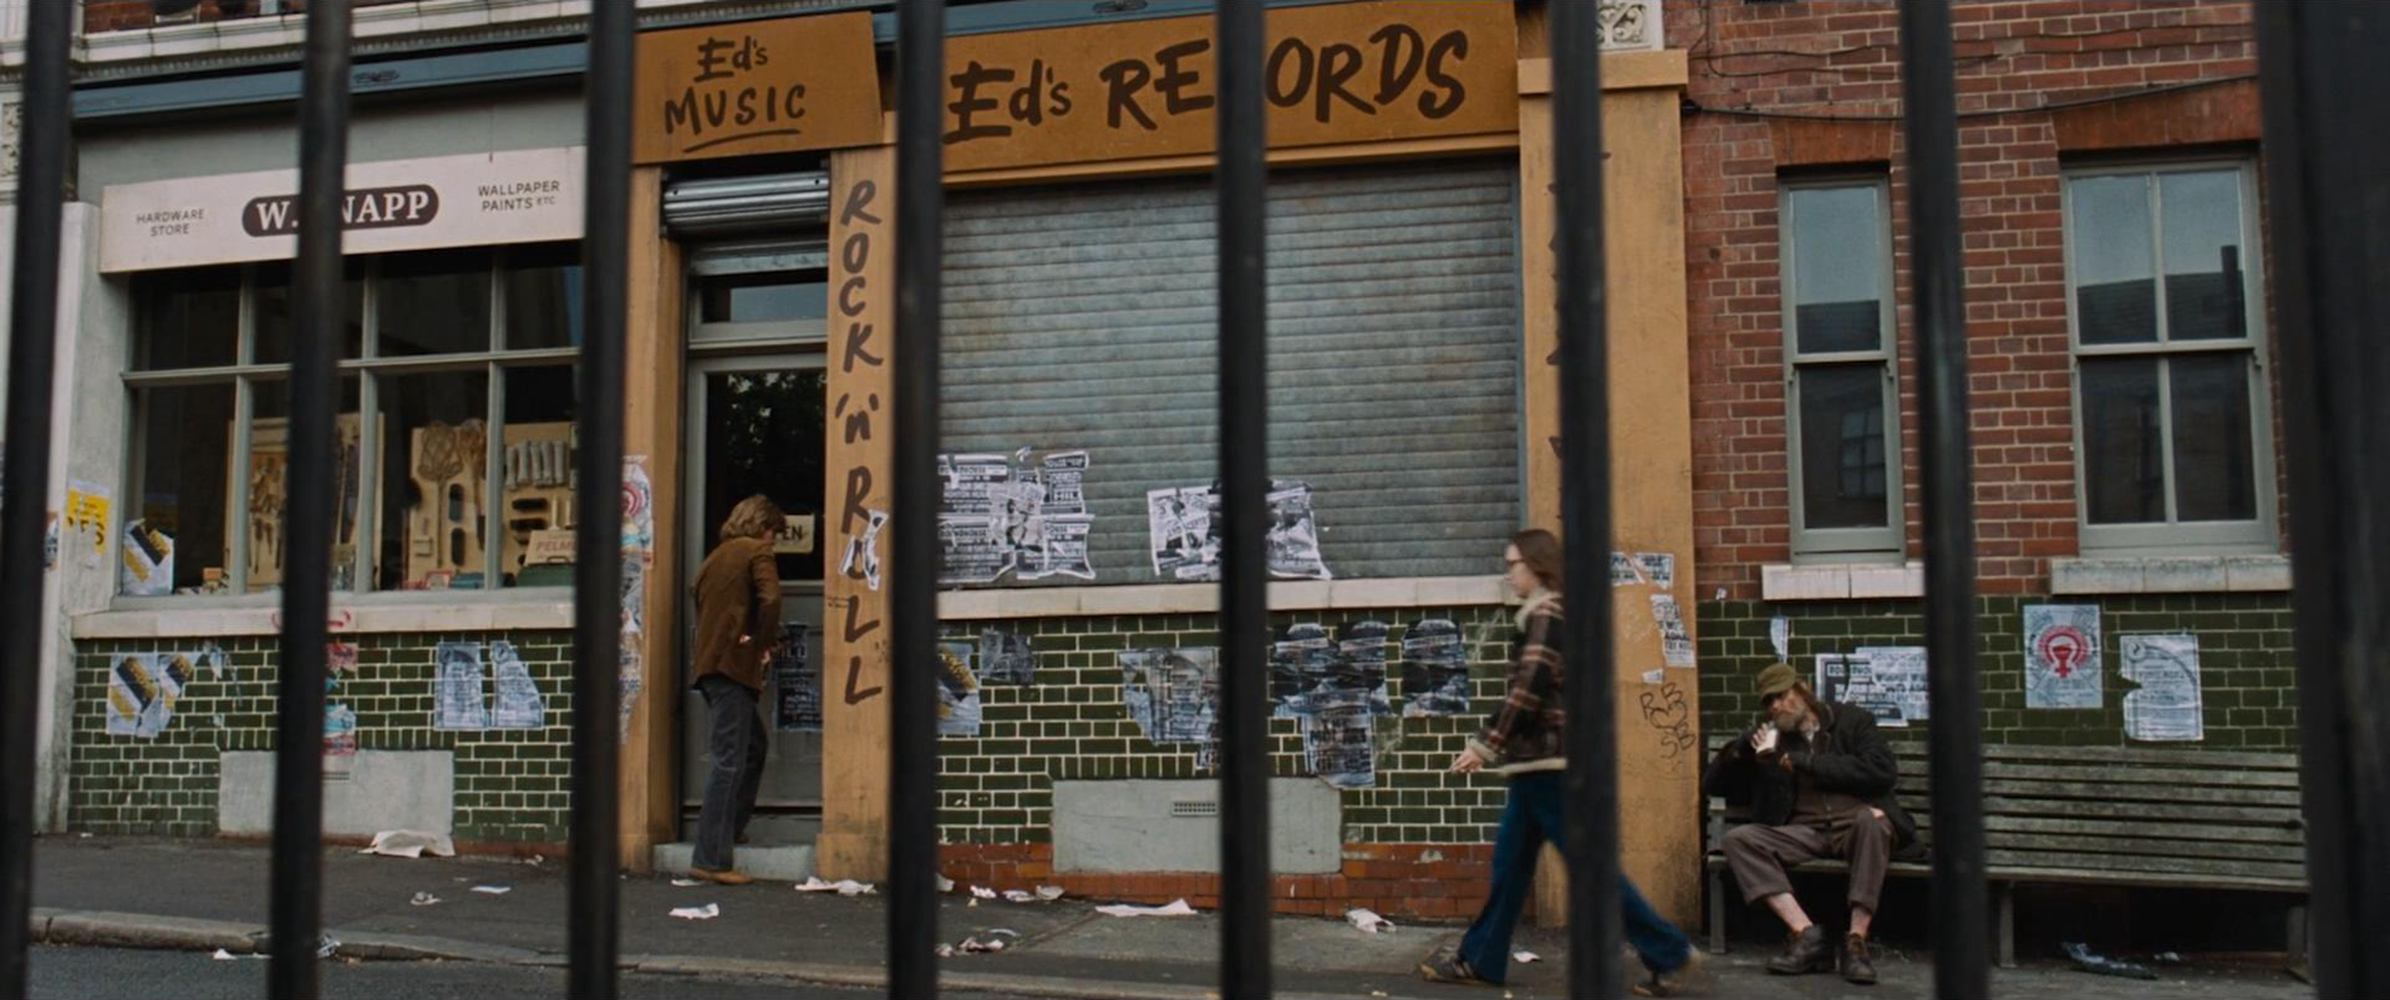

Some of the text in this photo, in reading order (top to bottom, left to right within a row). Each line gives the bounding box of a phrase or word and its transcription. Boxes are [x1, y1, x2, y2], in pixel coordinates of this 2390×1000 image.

[694, 36, 769, 83] Ed's
[941, 23, 1469, 145] Ed's REORDS
[664, 84, 807, 136] MUSIC
[478, 180, 561, 197] WALLPAPER
[482, 197, 534, 212] PAINTS
[136, 208, 205, 224] HARDWARE
[150, 223, 190, 237] STORE
[256, 190, 430, 231] W. NAPP
[838, 180, 885, 374] ROCK
